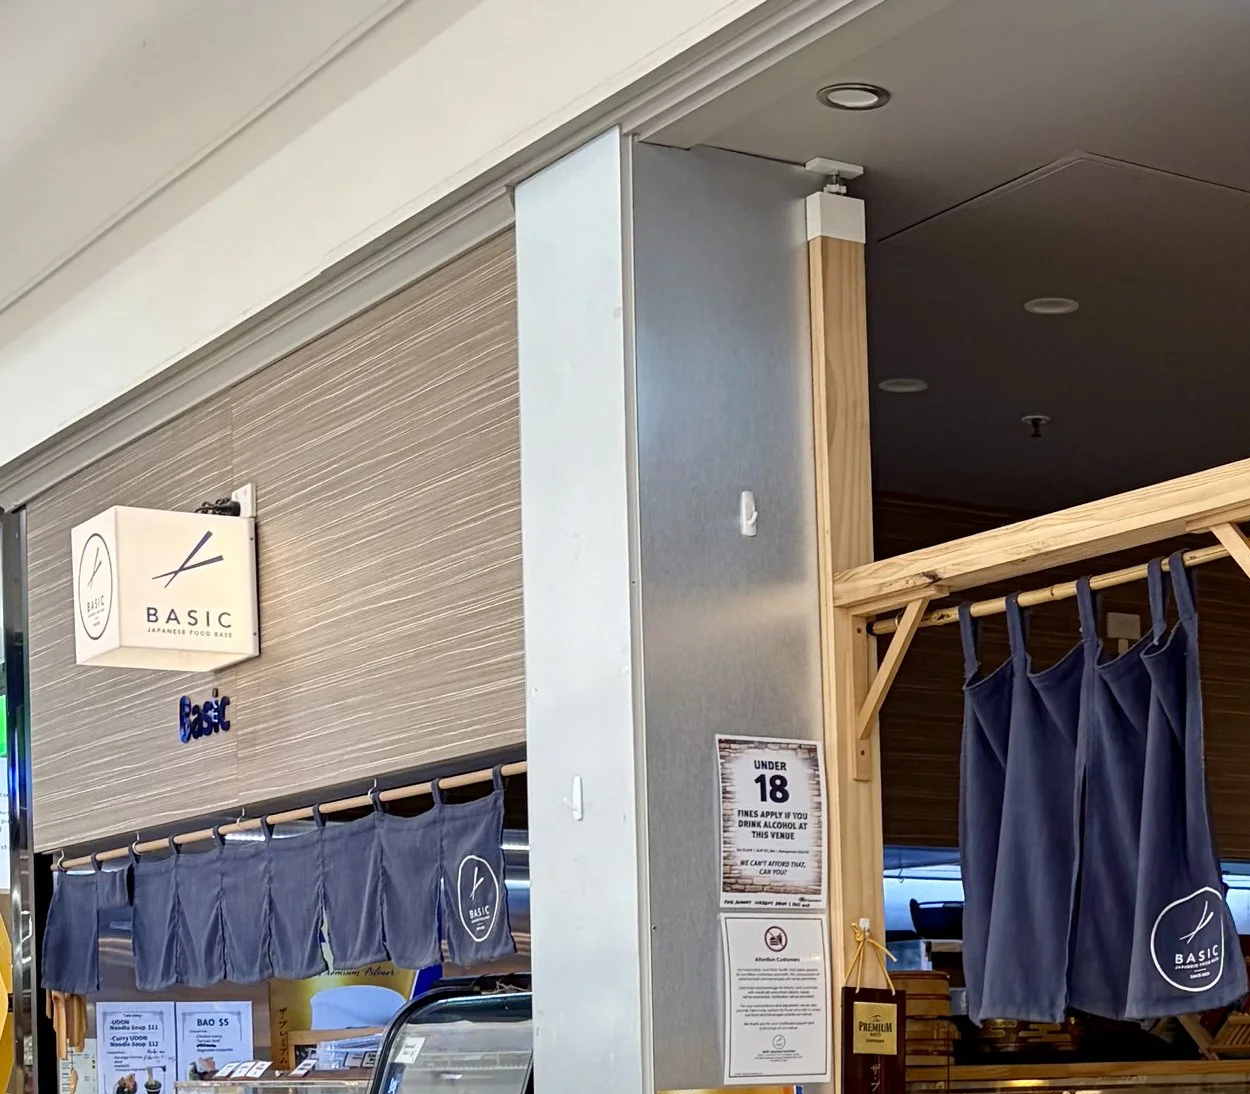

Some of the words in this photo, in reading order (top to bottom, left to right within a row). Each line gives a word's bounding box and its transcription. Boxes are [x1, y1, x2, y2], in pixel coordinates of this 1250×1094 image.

[86, 594, 105, 613] BASIC
[146, 606, 232, 629] BASIC
[147, 627, 186, 636] JAPANESE
[189, 630, 211, 638] FOOD
[178, 687, 231, 744] Basic
[753, 759, 788, 772] UNDER
[753, 773, 790, 804] 18
[737, 809, 759, 819] FINES
[760, 810, 783, 820] APPLY
[784, 811, 792, 820] IF
[793, 811, 809, 821] YOU
[738, 819, 762, 829] DRINK
[762, 820, 798, 831] ALCOHOL
[798, 822, 808, 831] AT
[751, 830, 769, 840] THIS
[770, 831, 796, 841] VENUE
[739, 859, 749, 868] WE
[749, 860, 767, 868] CAN'T
[767, 860, 790, 869] AFFORD
[790, 861, 807, 870] THAT,
[758, 868, 771, 876] CAN
[772, 868, 788, 877] YOU?
[469, 904, 491, 920] BASIC
[1174, 944, 1219, 965] BASIC
[197, 1018, 215, 1027] BAO
[218, 1018, 229, 1027] $5
[858, 1020, 893, 1033] PREMIUM
